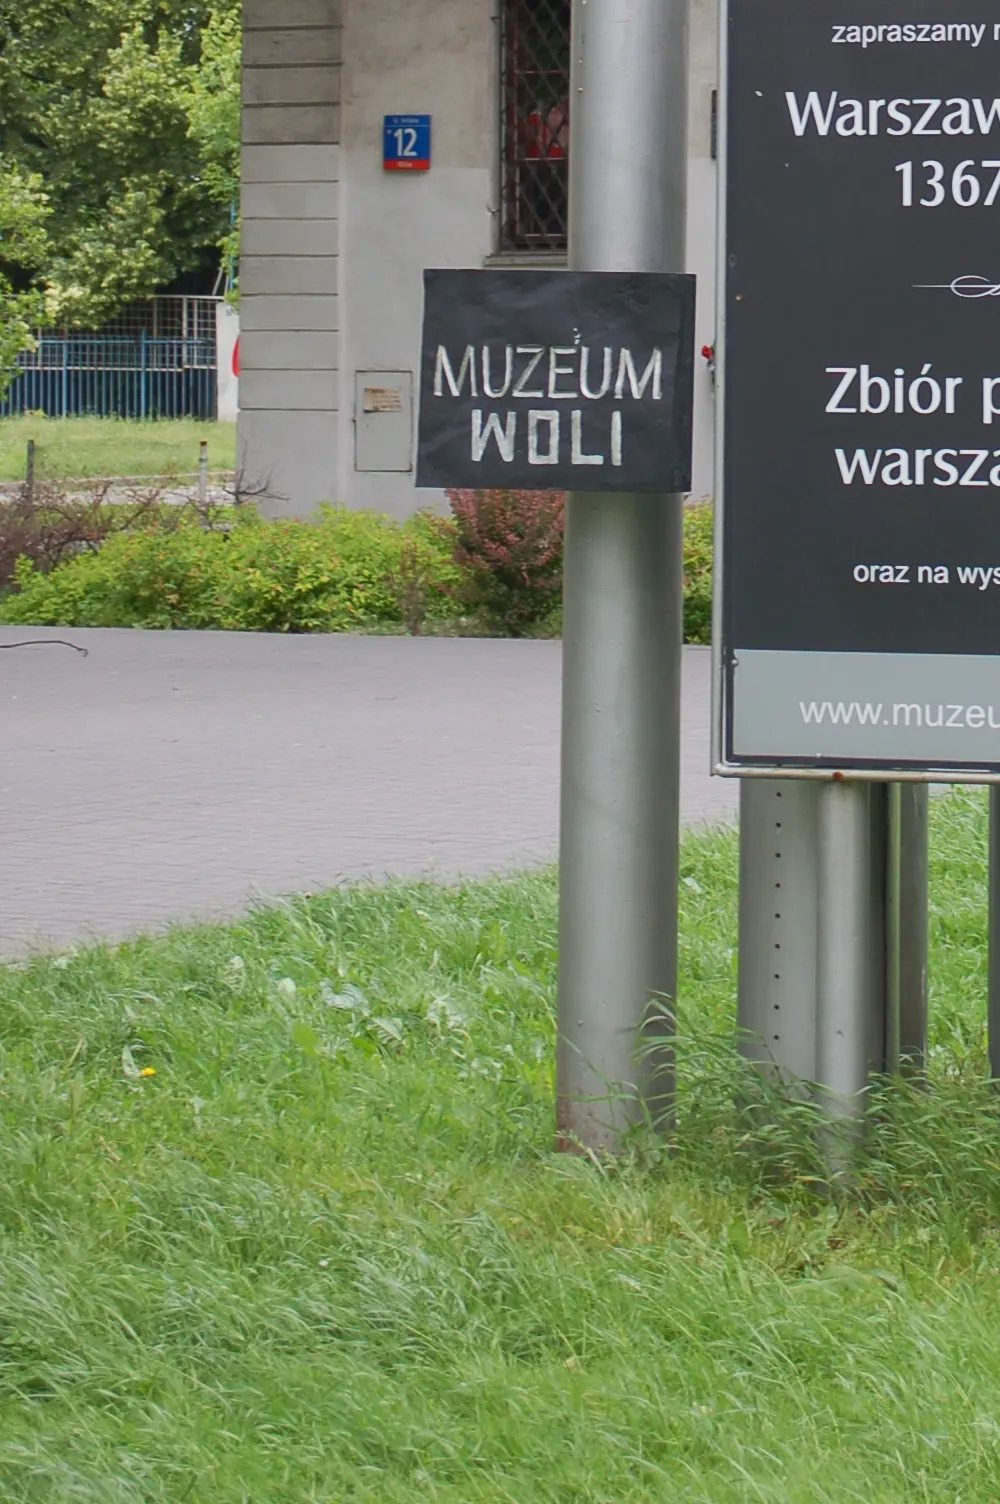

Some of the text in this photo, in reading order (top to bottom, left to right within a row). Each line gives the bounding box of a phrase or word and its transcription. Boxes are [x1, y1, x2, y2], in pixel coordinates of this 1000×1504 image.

[831, 23, 987, 49] zapraszamy
[394, 128, 417, 156] 12
[433, 343, 662, 400] MUZEUM
[825, 363, 963, 414] Zbiór
[471, 409, 622, 466] WOLI
[853, 564, 910, 583] oraz
[917, 565, 949, 584] na
